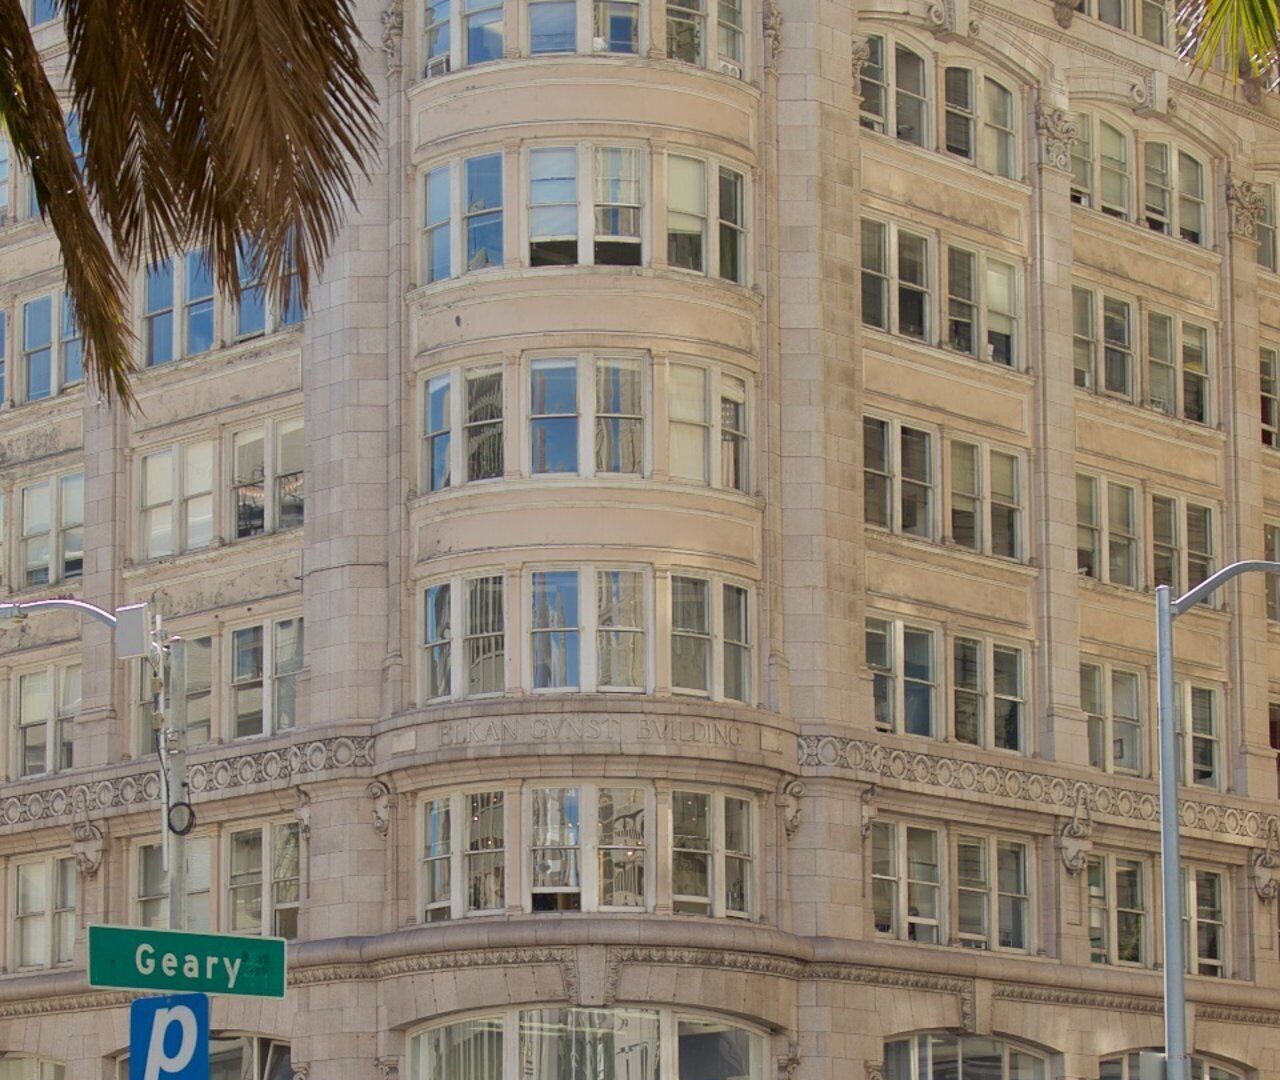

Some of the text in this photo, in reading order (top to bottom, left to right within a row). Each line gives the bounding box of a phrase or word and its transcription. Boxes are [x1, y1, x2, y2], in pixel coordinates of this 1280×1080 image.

[438, 718, 519, 747] ELKAN
[636, 719, 742, 746] BVILDING
[135, 943, 241, 989] Geary
